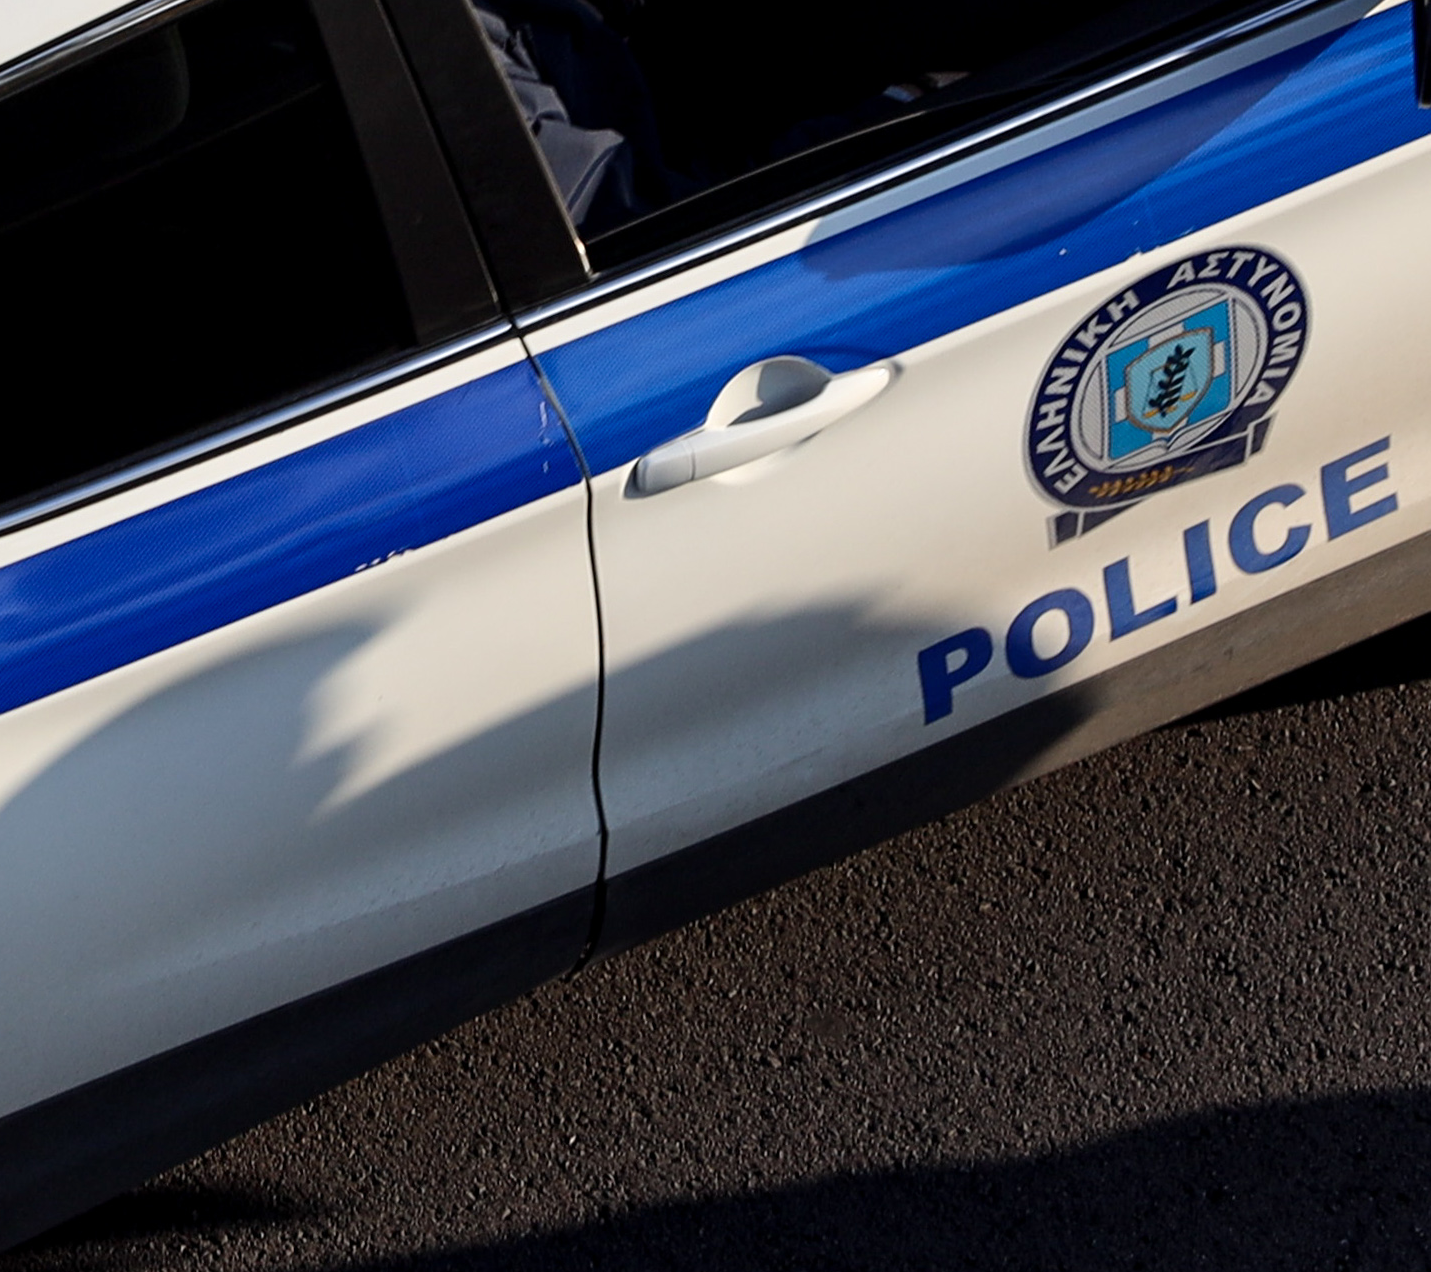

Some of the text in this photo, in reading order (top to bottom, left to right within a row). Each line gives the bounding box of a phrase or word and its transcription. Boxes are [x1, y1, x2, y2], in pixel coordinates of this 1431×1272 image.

[1035, 250, 1303, 496] ΕΛΛΗΝΙΚΗ ΑΣΤΥΝΟΜΙΑ
[917, 435, 1400, 726] POLICE
